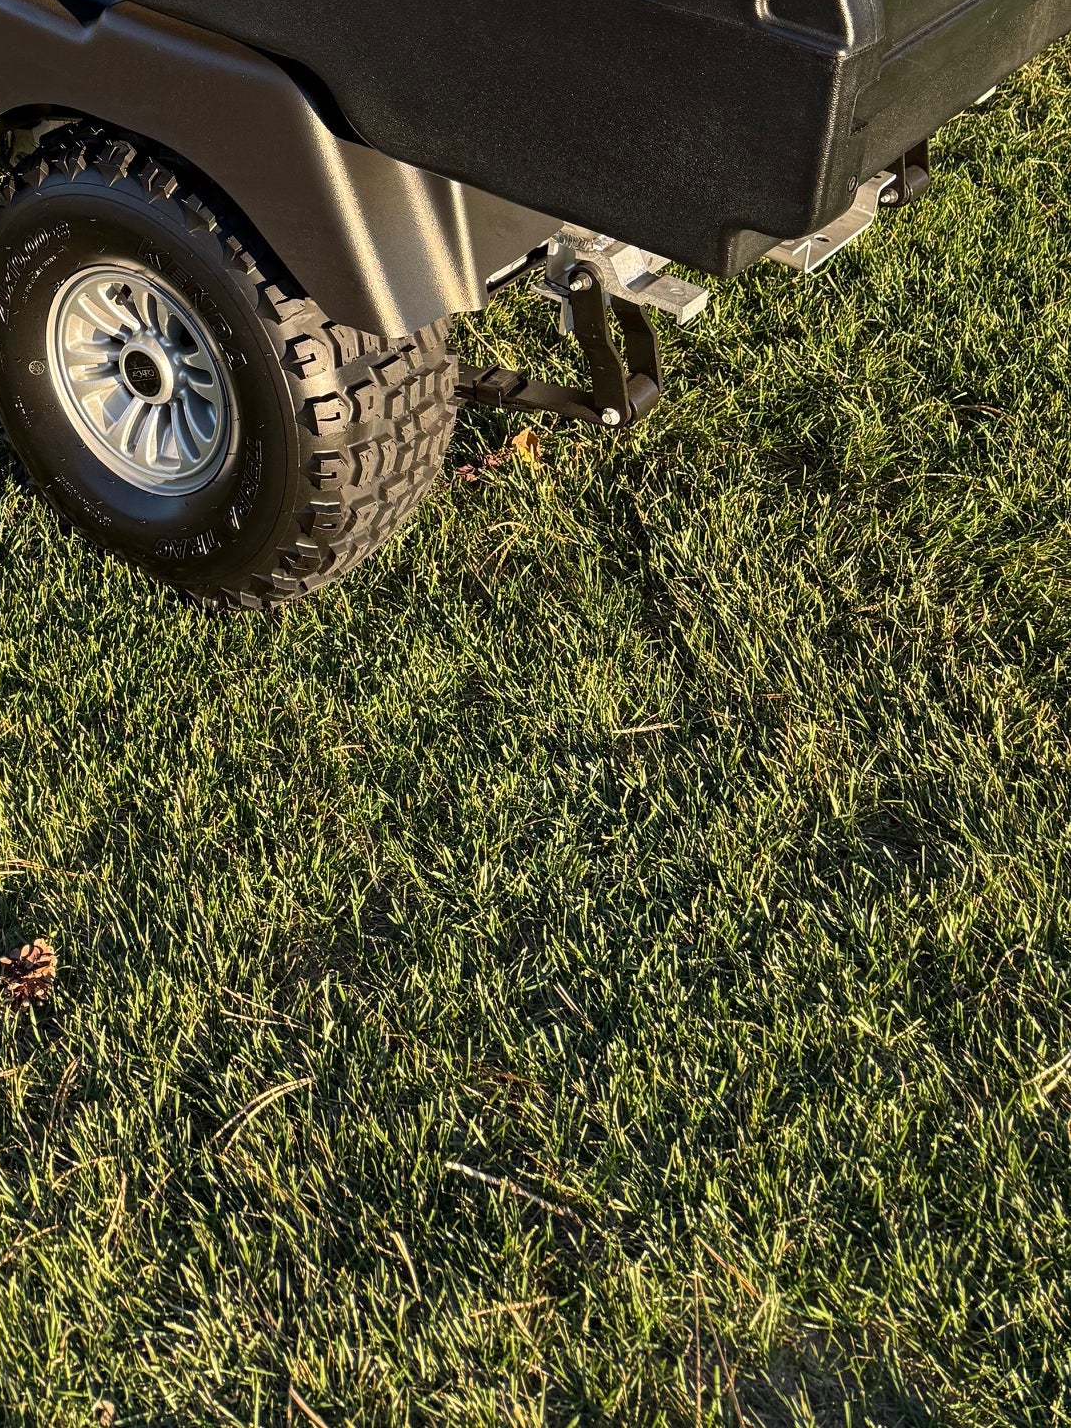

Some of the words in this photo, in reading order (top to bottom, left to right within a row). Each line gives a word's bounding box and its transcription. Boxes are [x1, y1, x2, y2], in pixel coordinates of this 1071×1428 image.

[137, 234, 248, 372] KENDA
[223, 437, 263, 533] TERRA
[155, 529, 222, 560] TRAC
